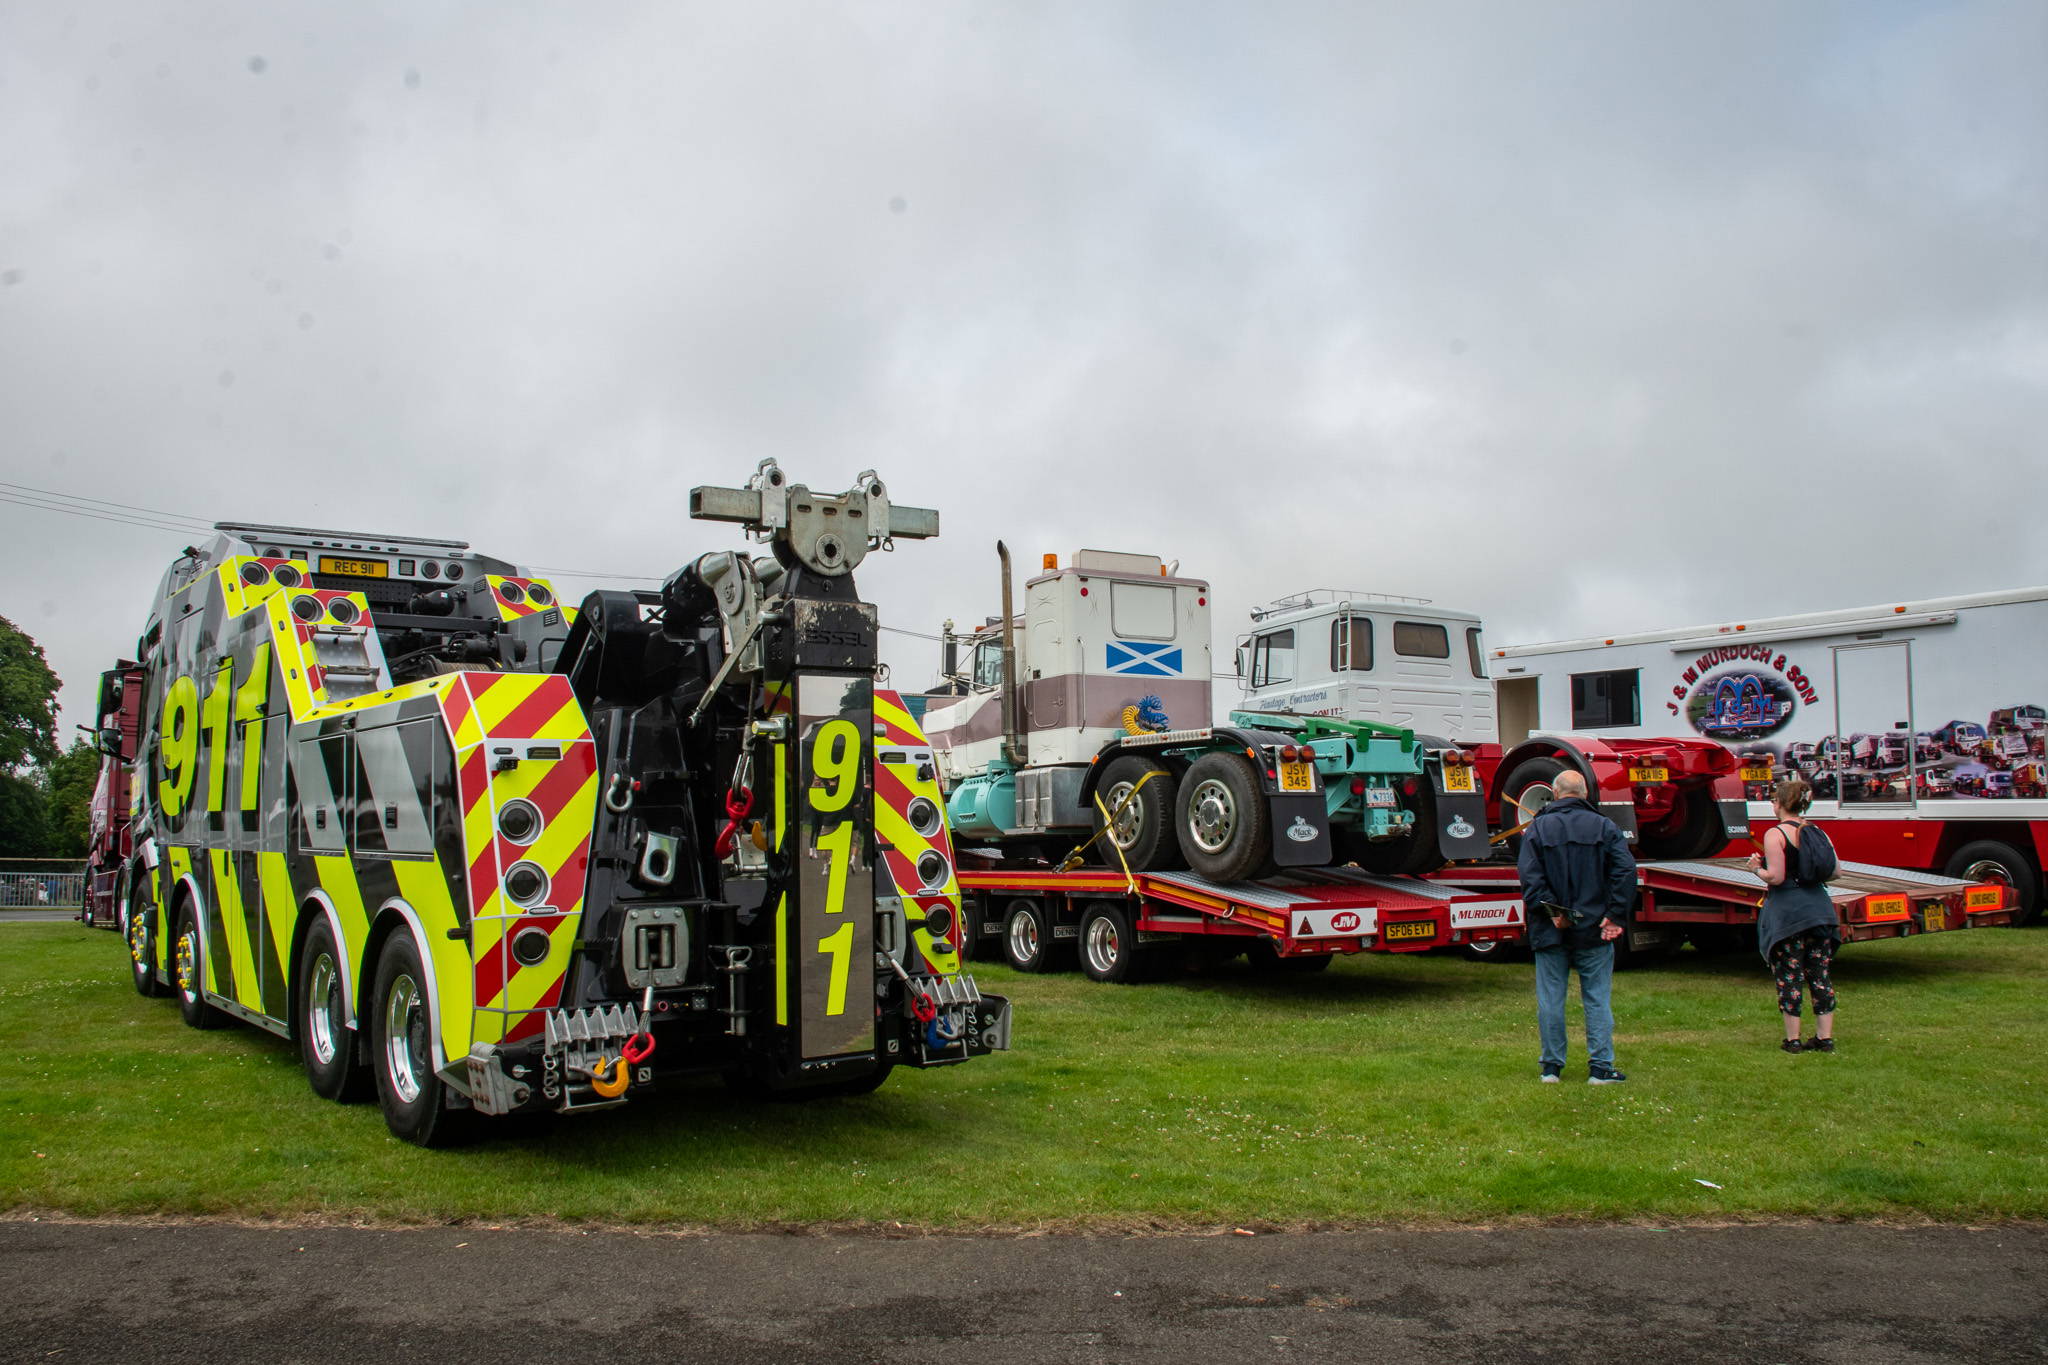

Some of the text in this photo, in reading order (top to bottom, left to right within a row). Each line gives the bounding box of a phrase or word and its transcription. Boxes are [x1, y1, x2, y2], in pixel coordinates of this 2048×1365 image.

[334, 561, 358, 573] REC
[1666, 644, 1820, 717] J & M MURDOCH & SON
[160, 641, 270, 817] 911
[1286, 764, 1307, 776] JSV
[1449, 766, 1468, 777] JSV
[1287, 776, 1308, 788] 345
[1450, 777, 1469, 789] 345
[1457, 909, 1506, 920] MURDOCH
[1333, 914, 1358, 929] JM
[1389, 923, 1432, 937] SF06 EVT
